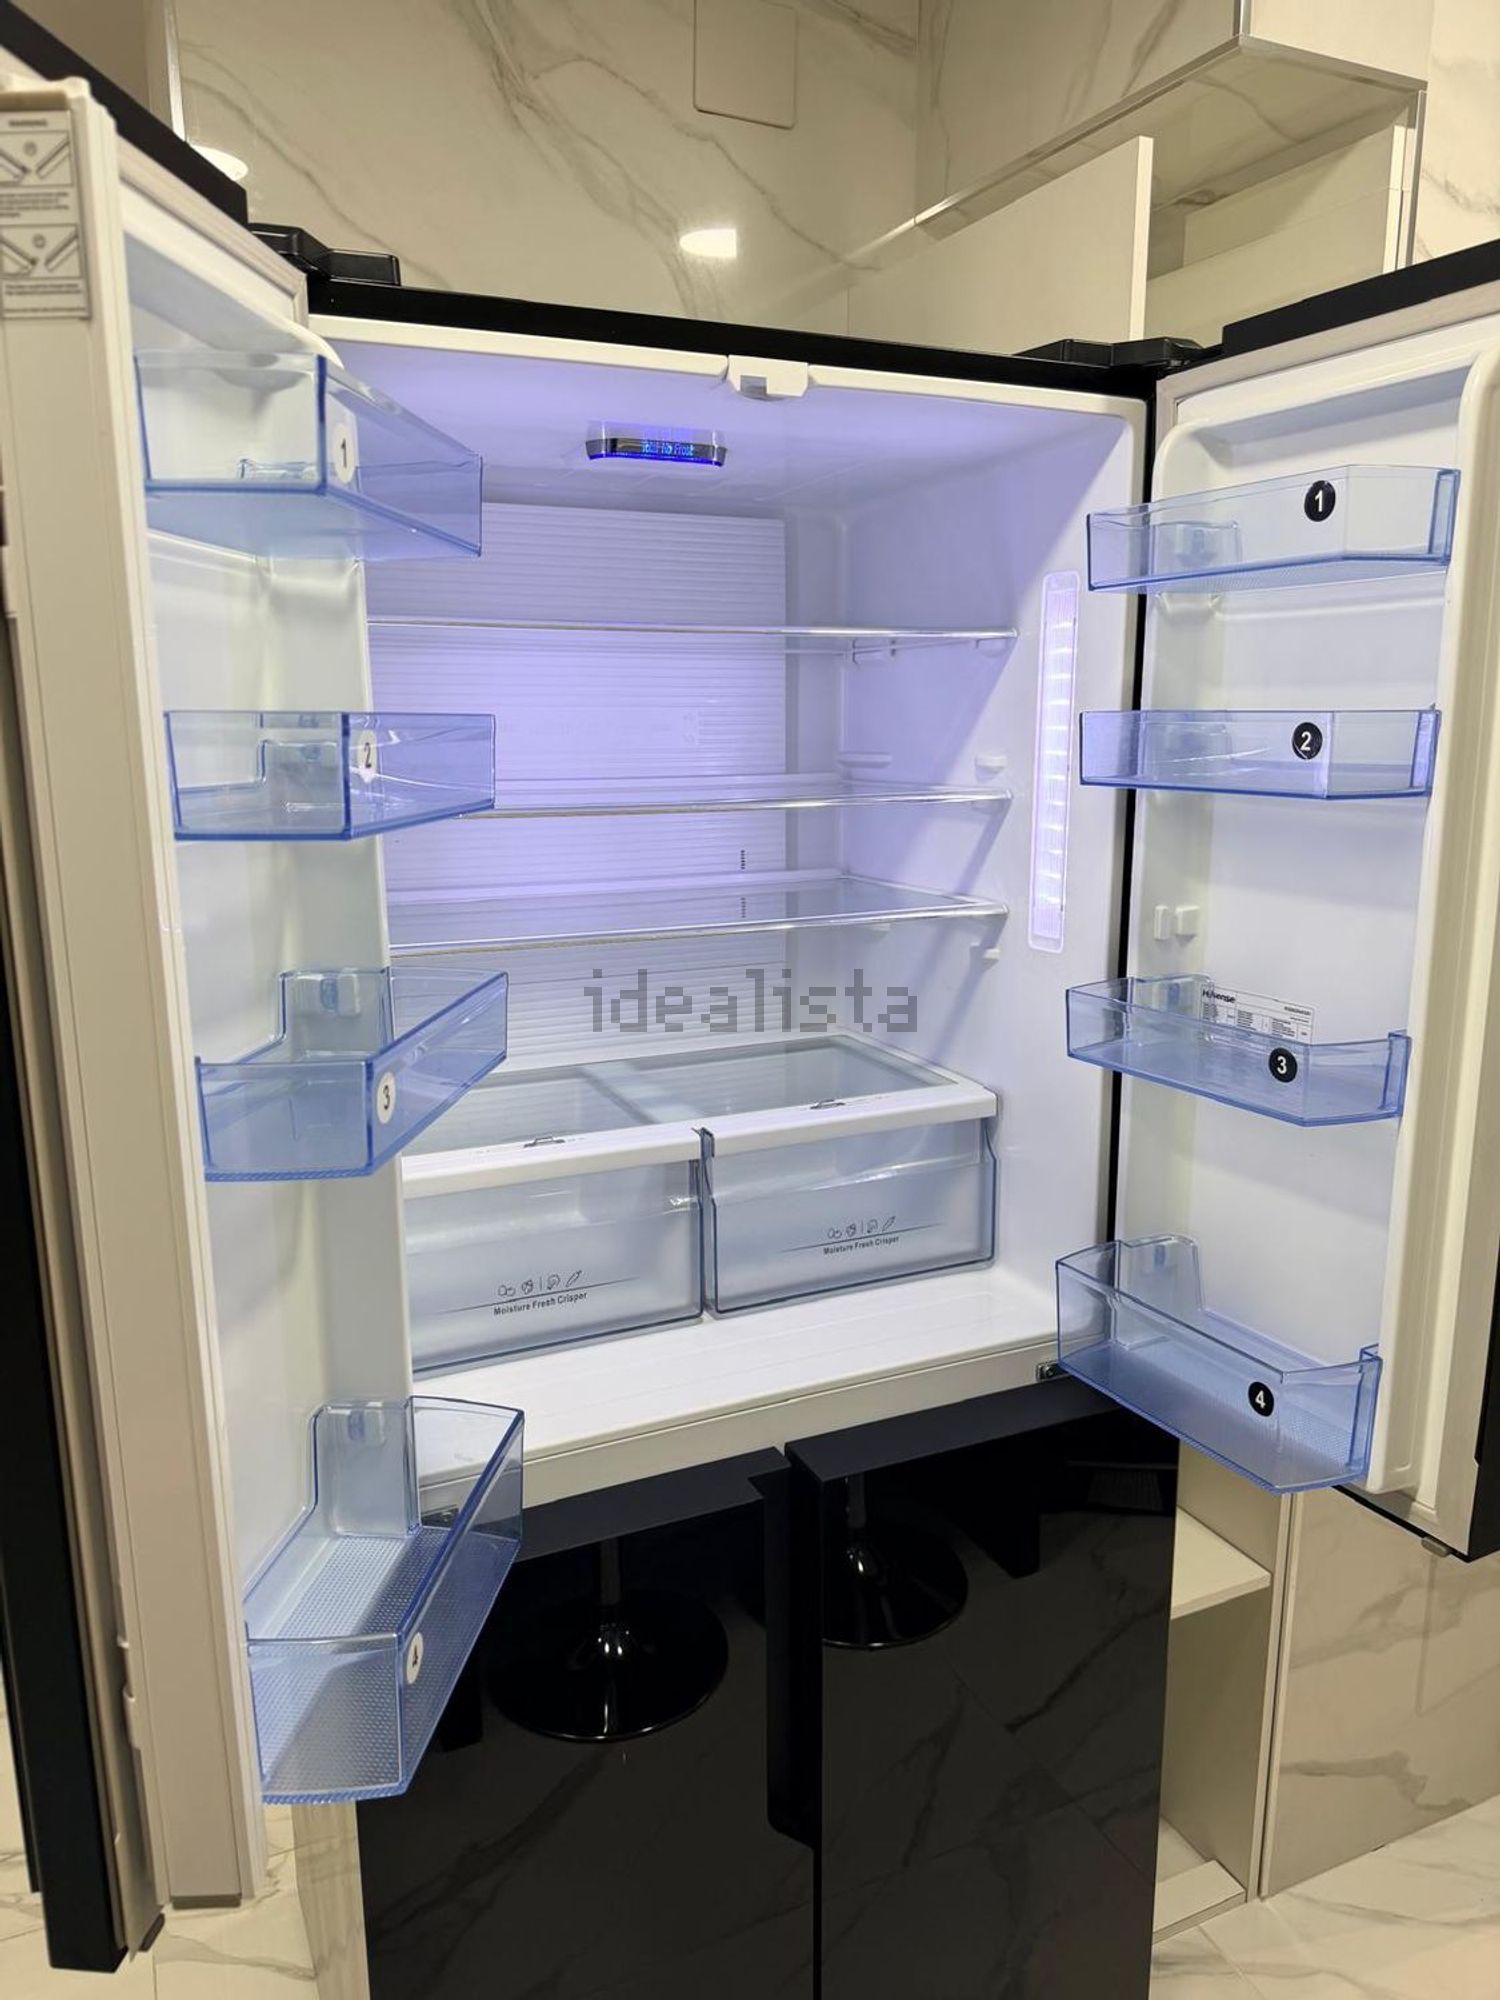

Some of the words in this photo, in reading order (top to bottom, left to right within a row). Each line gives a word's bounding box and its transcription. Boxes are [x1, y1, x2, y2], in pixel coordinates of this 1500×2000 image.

[340, 437, 348, 469] 1
[1314, 489, 1323, 512] 1
[1300, 731, 1312, 751] 2
[364, 742, 372, 769] 2
[1277, 1056, 1288, 1075] 3
[383, 1085, 391, 1111] 3
[824, 1244, 854, 1255] Moisture
[855, 1240, 874, 1249] Fresh
[874, 1236, 899, 1246] Crisper
[493, 1303, 531, 1316] Moisture
[532, 1297, 557, 1309] Fresh
[557, 1292, 587, 1305] Crisper
[1255, 1390, 1266, 1409] 4
